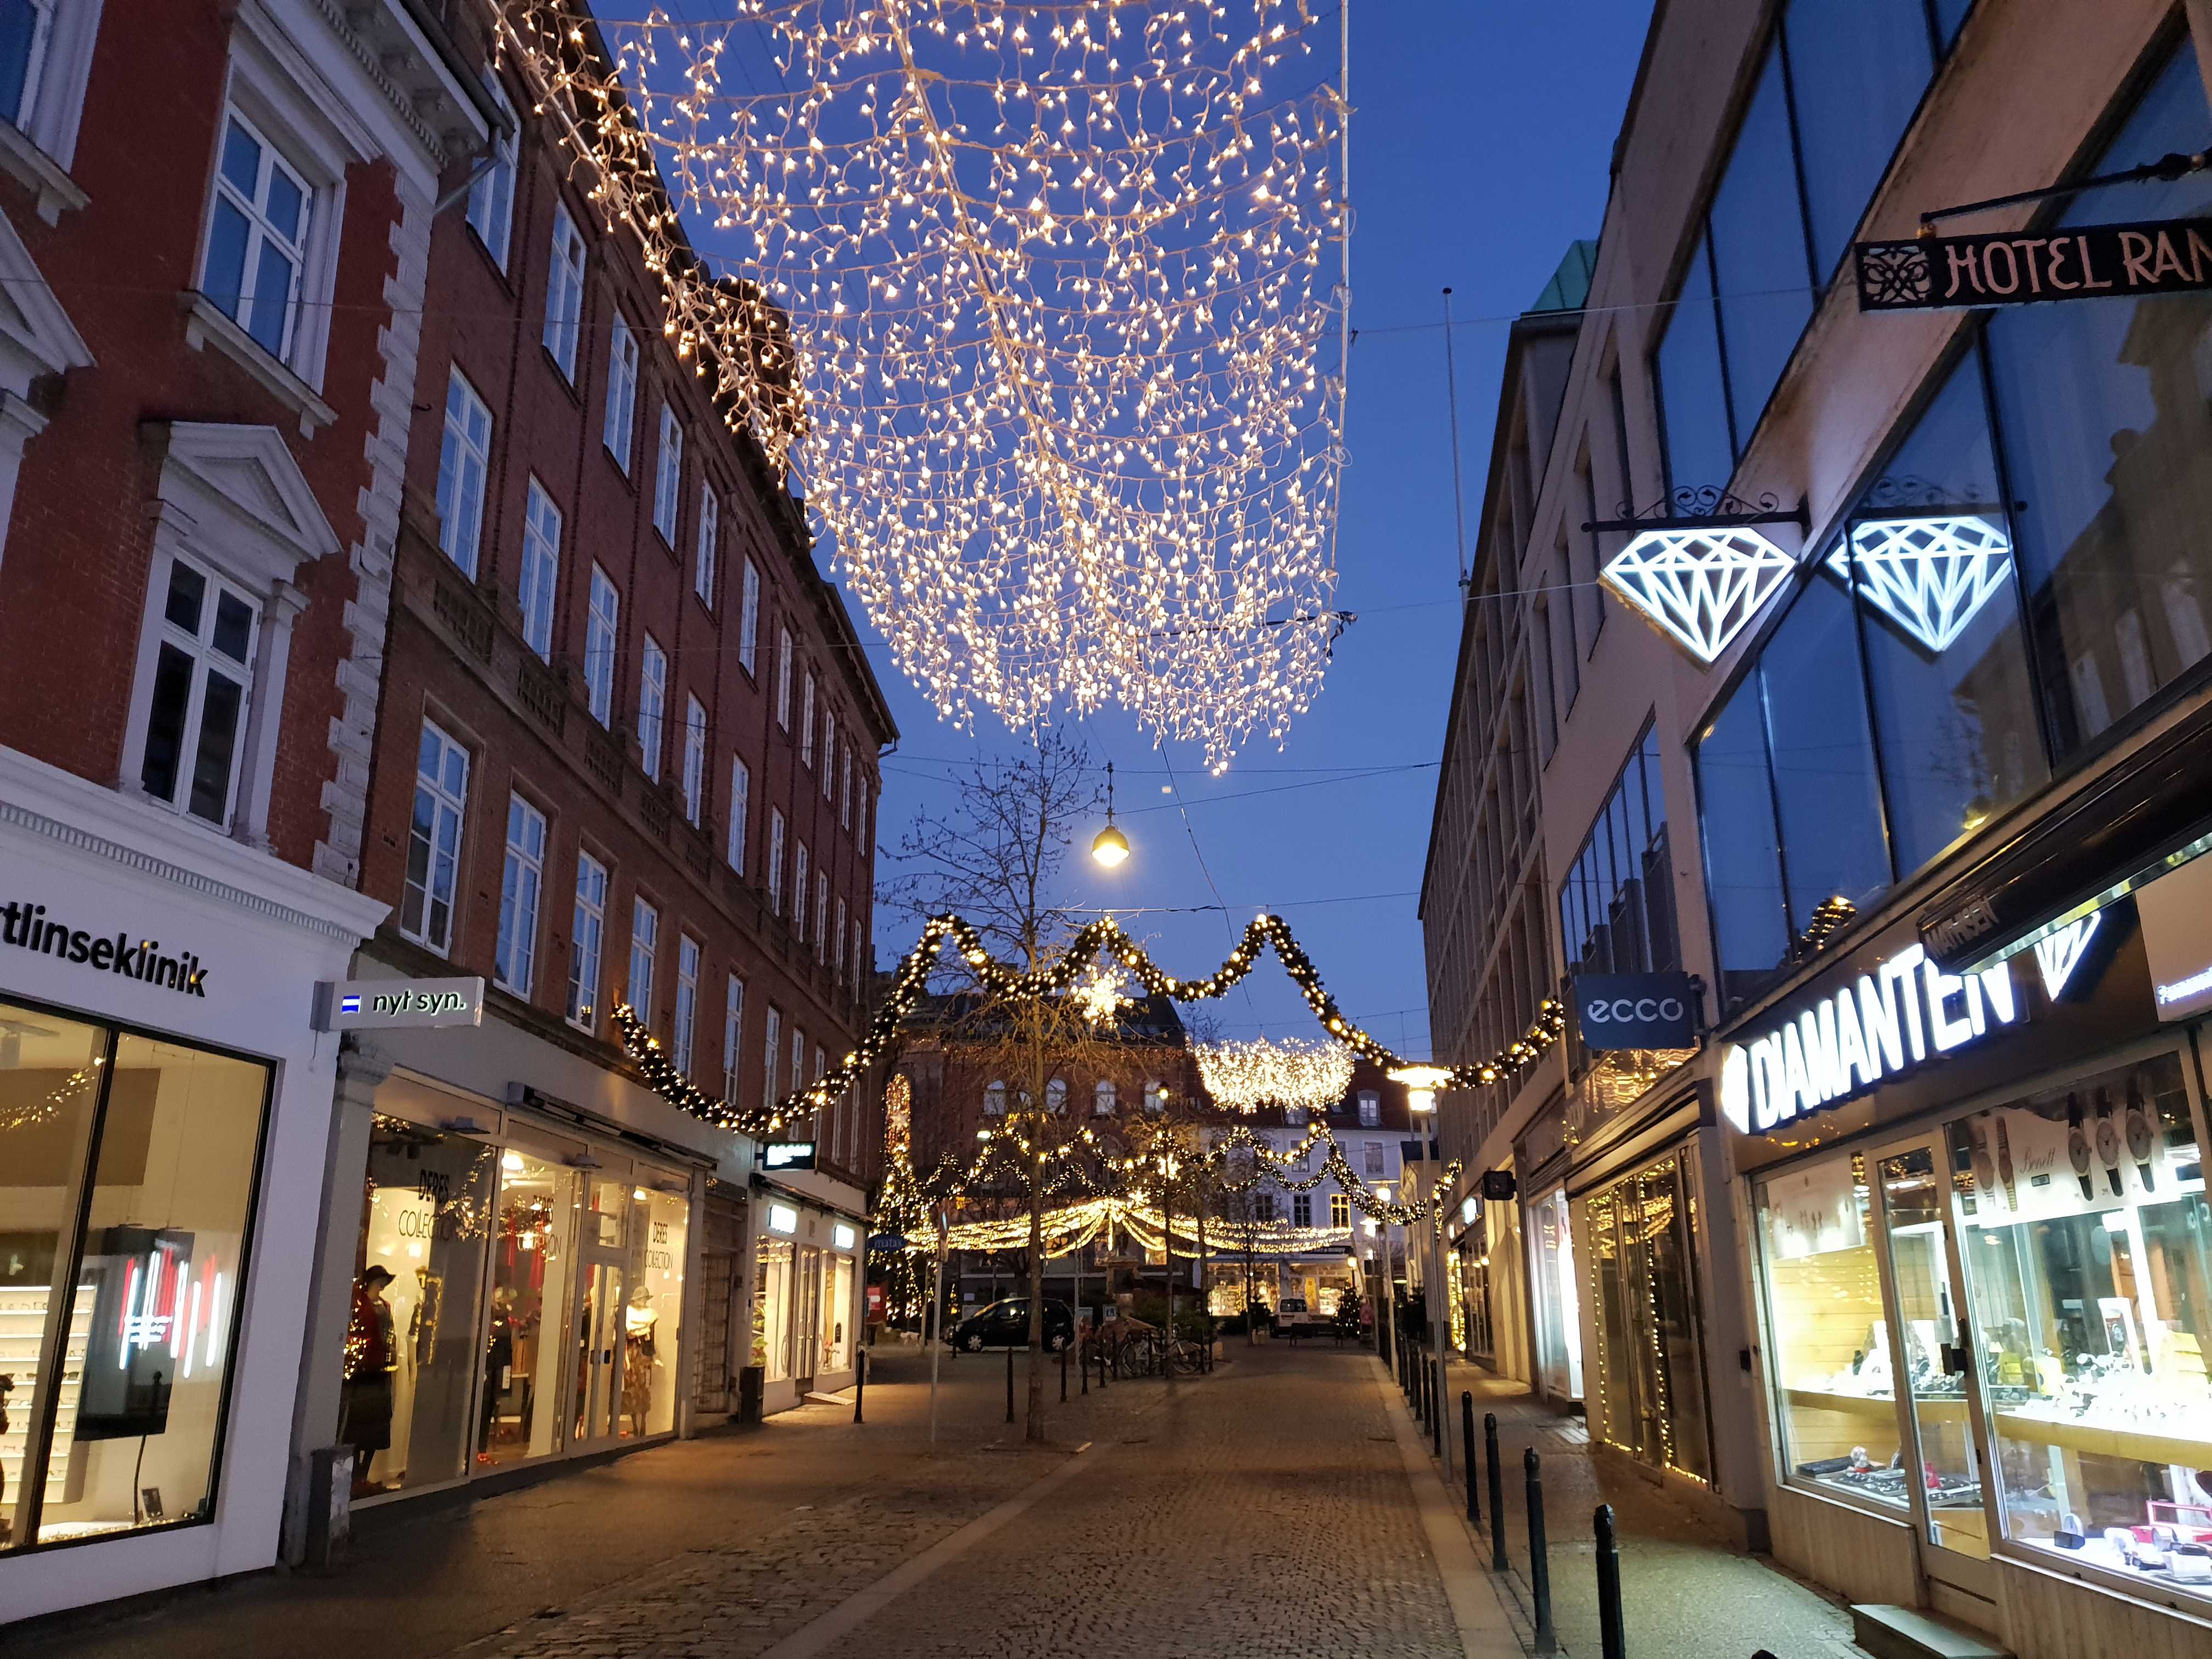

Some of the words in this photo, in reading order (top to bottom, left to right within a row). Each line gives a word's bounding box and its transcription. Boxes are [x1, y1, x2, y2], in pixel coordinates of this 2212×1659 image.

[1945, 236, 2112, 298] HOTEL
[0, 901, 208, 997] tlinseklinik
[373, 989, 413, 1017] nyt
[416, 992, 467, 1017] syn.
[1588, 997, 1684, 1023] ecco
[1751, 943, 2015, 1130] DIAMANTEN
